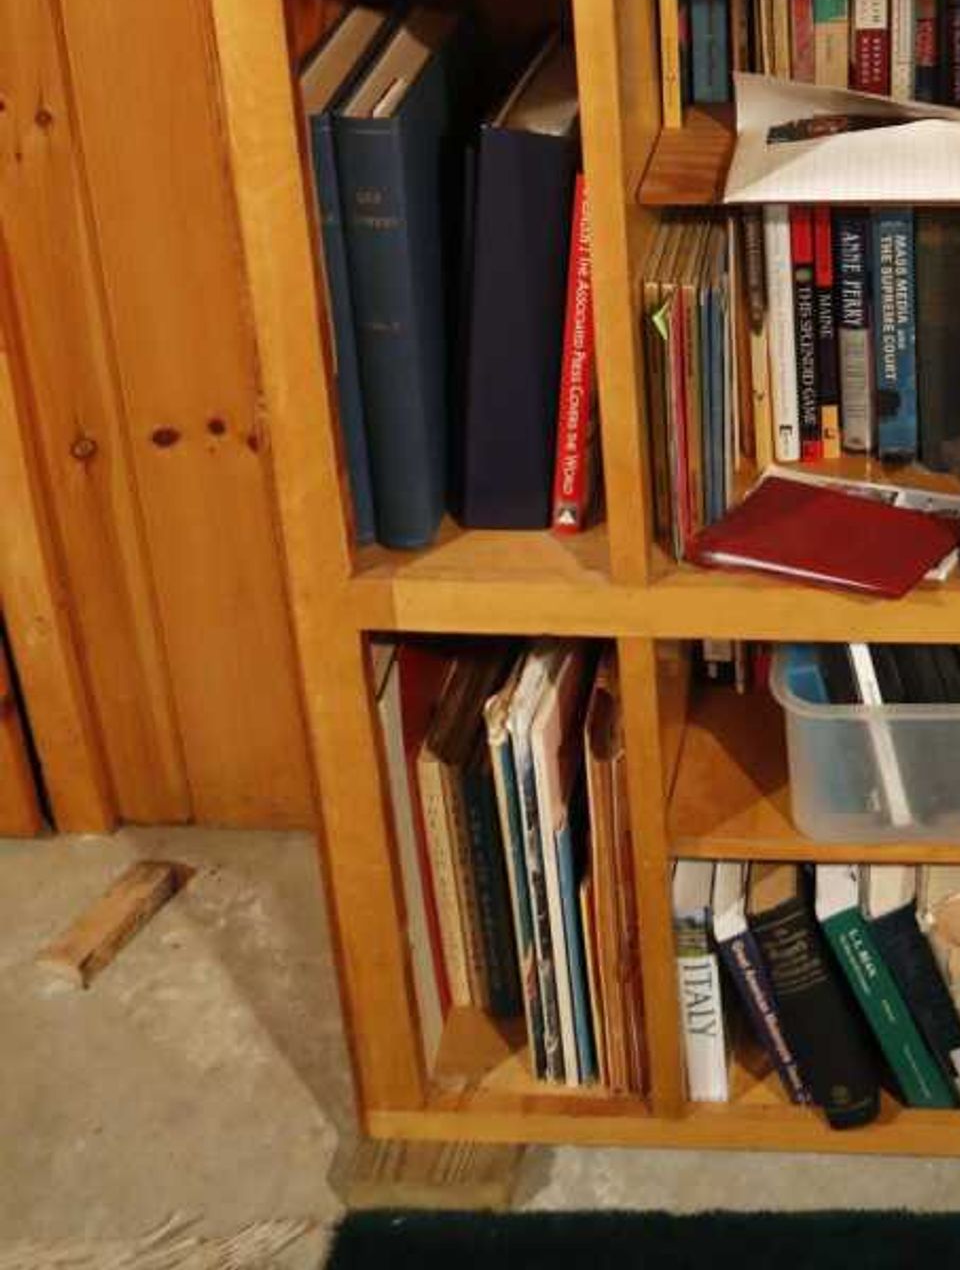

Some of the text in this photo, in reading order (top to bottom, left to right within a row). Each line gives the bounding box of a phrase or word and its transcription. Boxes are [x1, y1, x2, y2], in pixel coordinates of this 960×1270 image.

[895, 234, 908, 273] MASS
[841, 232, 864, 326] ANNE PERRY
[896, 277, 908, 324] MEDIA
[818, 293, 832, 338] MAINE
[880, 235, 897, 380] THE SUPREME COURT
[571, 351, 585, 383] PRESS
[799, 320, 815, 386] SPLENDID
[567, 385, 583, 430] COVERS
[801, 387, 817, 424] GAME
[562, 454, 577, 494] WORLD
[683, 963, 718, 1037] ITALY
